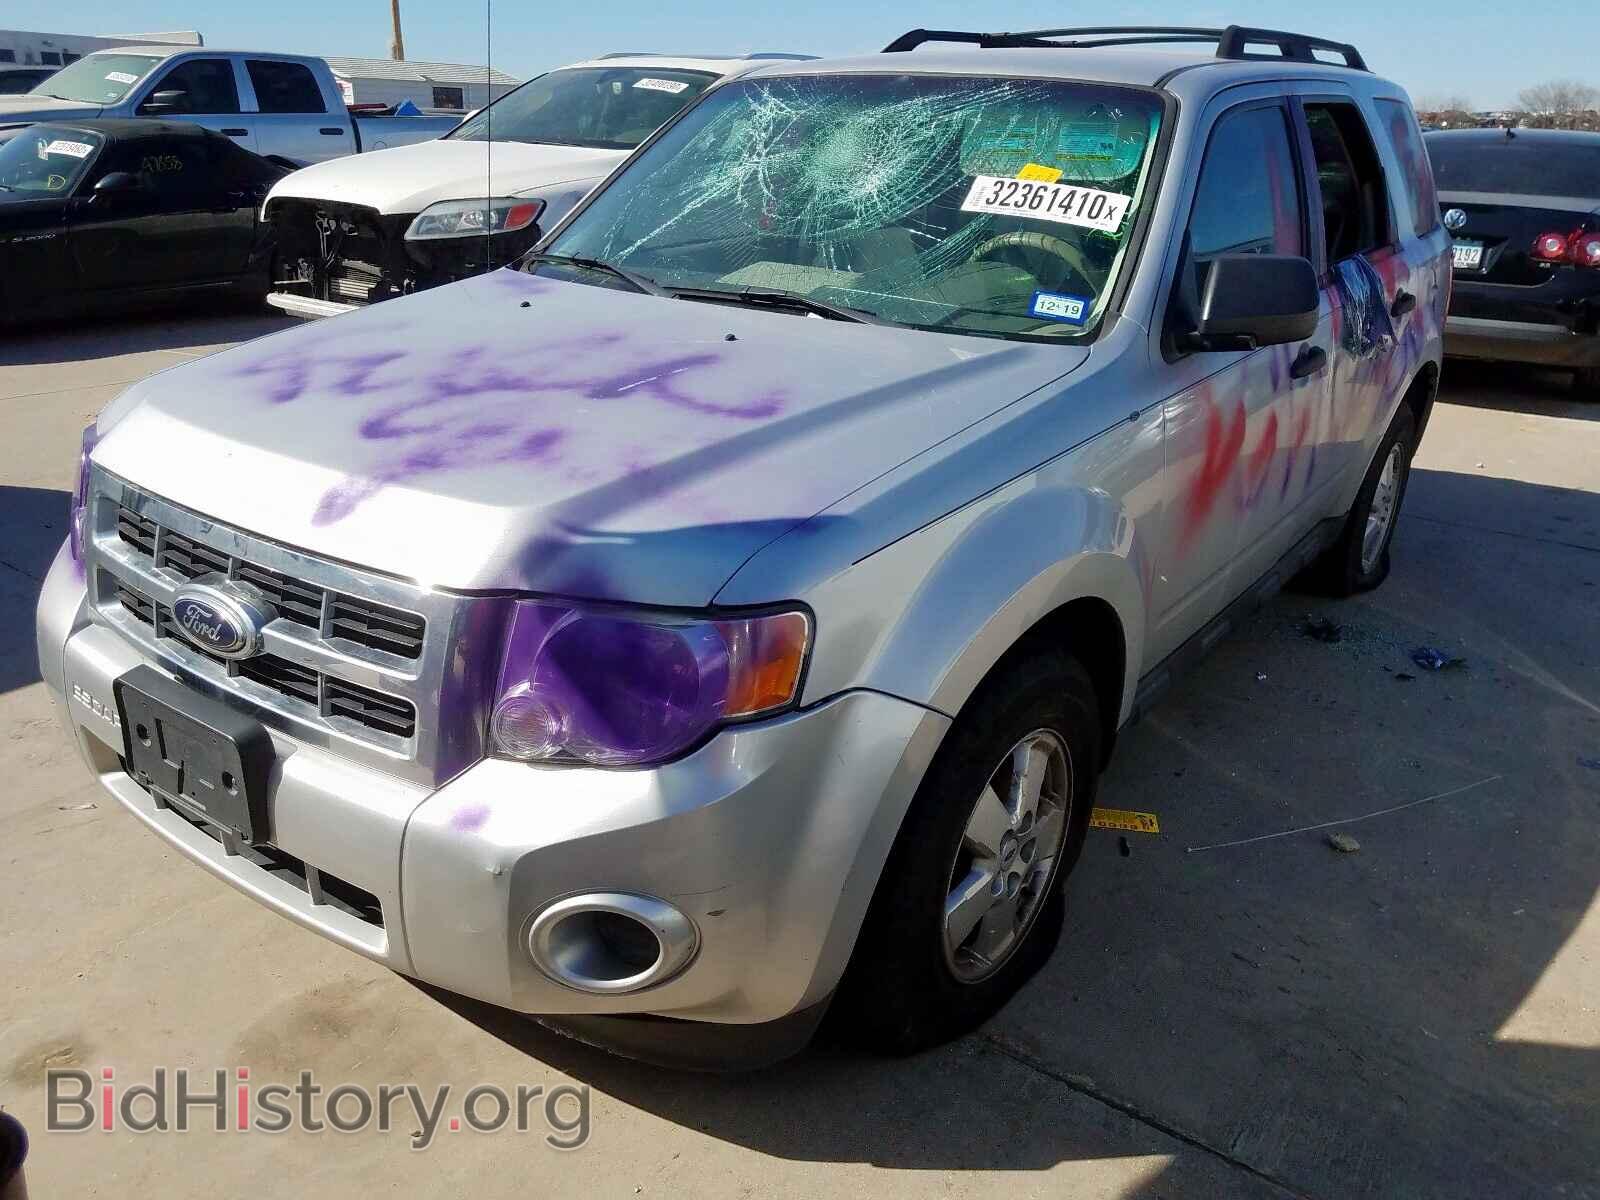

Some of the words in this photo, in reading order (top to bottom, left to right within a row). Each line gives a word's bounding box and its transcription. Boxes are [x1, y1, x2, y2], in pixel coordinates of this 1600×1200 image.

[1040, 301, 1056, 311] 12
[1064, 304, 1080, 315] 19
[183, 603, 221, 642] Ford
